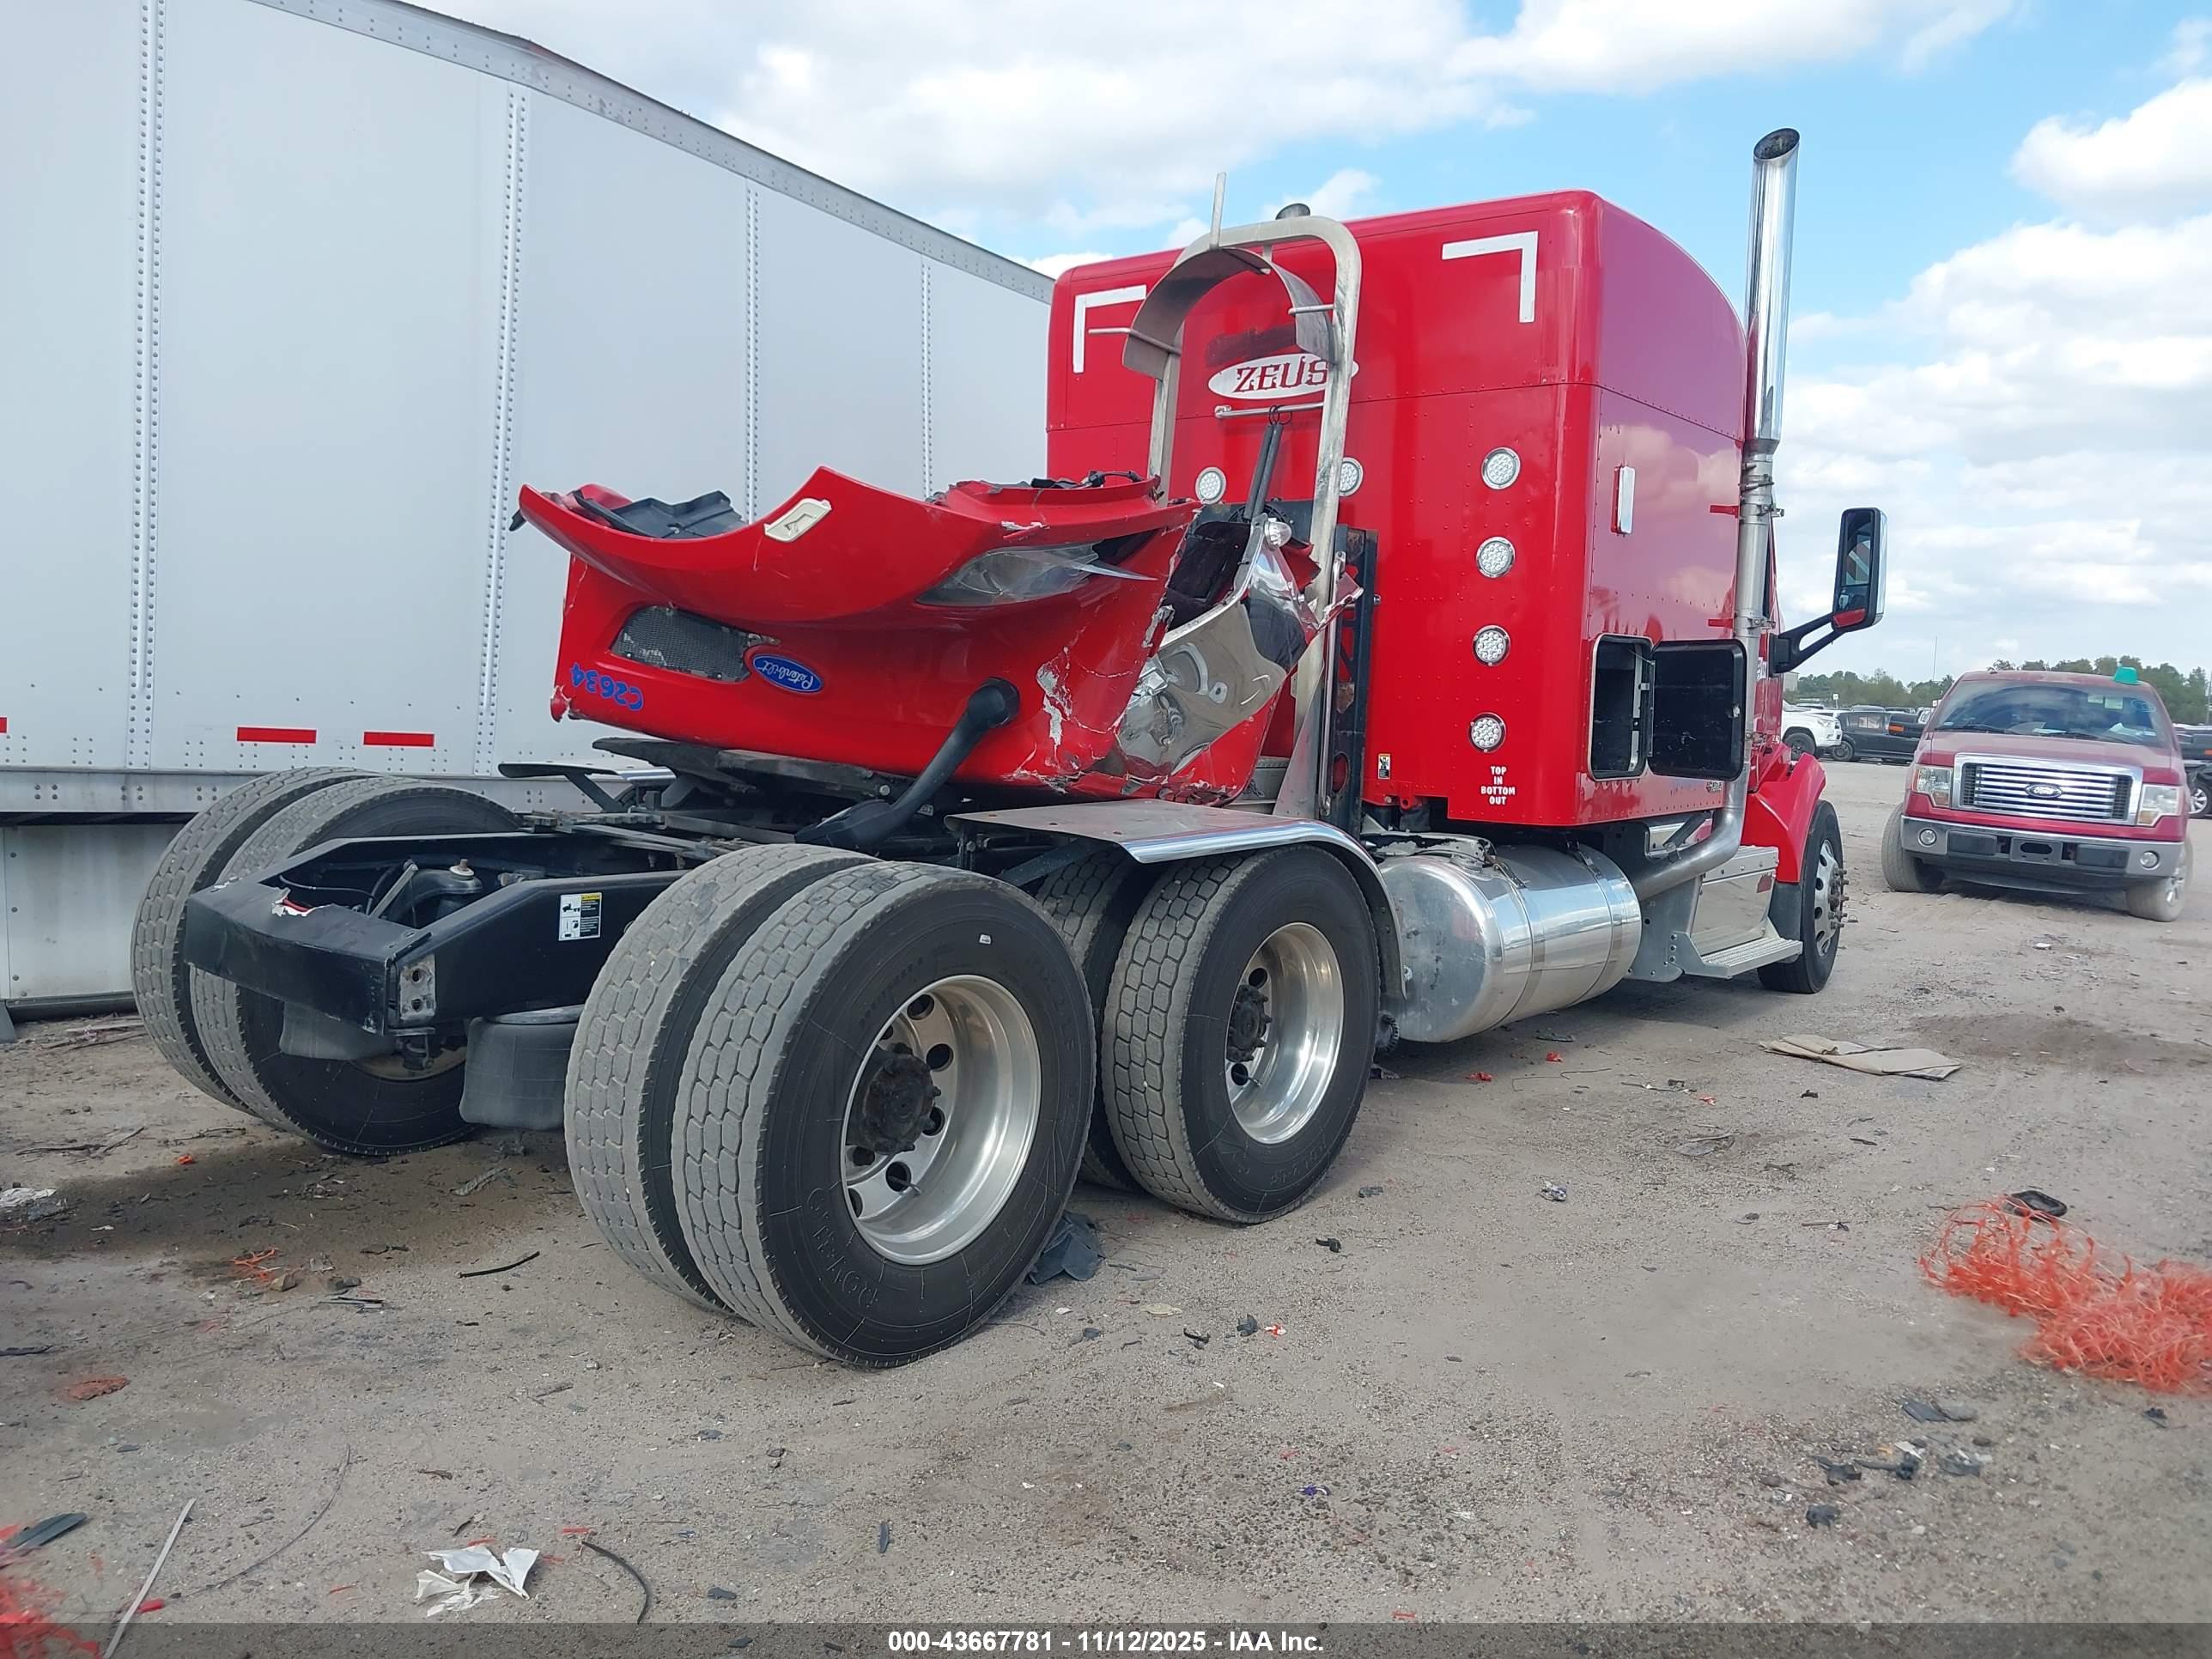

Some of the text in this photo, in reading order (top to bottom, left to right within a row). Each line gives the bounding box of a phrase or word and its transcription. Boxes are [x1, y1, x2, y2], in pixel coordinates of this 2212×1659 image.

[1232, 356, 1329, 392] ZEUS
[757, 660, 815, 690] Peterbilt
[570, 662, 643, 711] C2634
[1491, 766, 1507, 775] TOP
[1493, 776, 1504, 785] IN
[1480, 786, 1516, 795] BOTTOM
[1489, 796, 1507, 805] OUT
